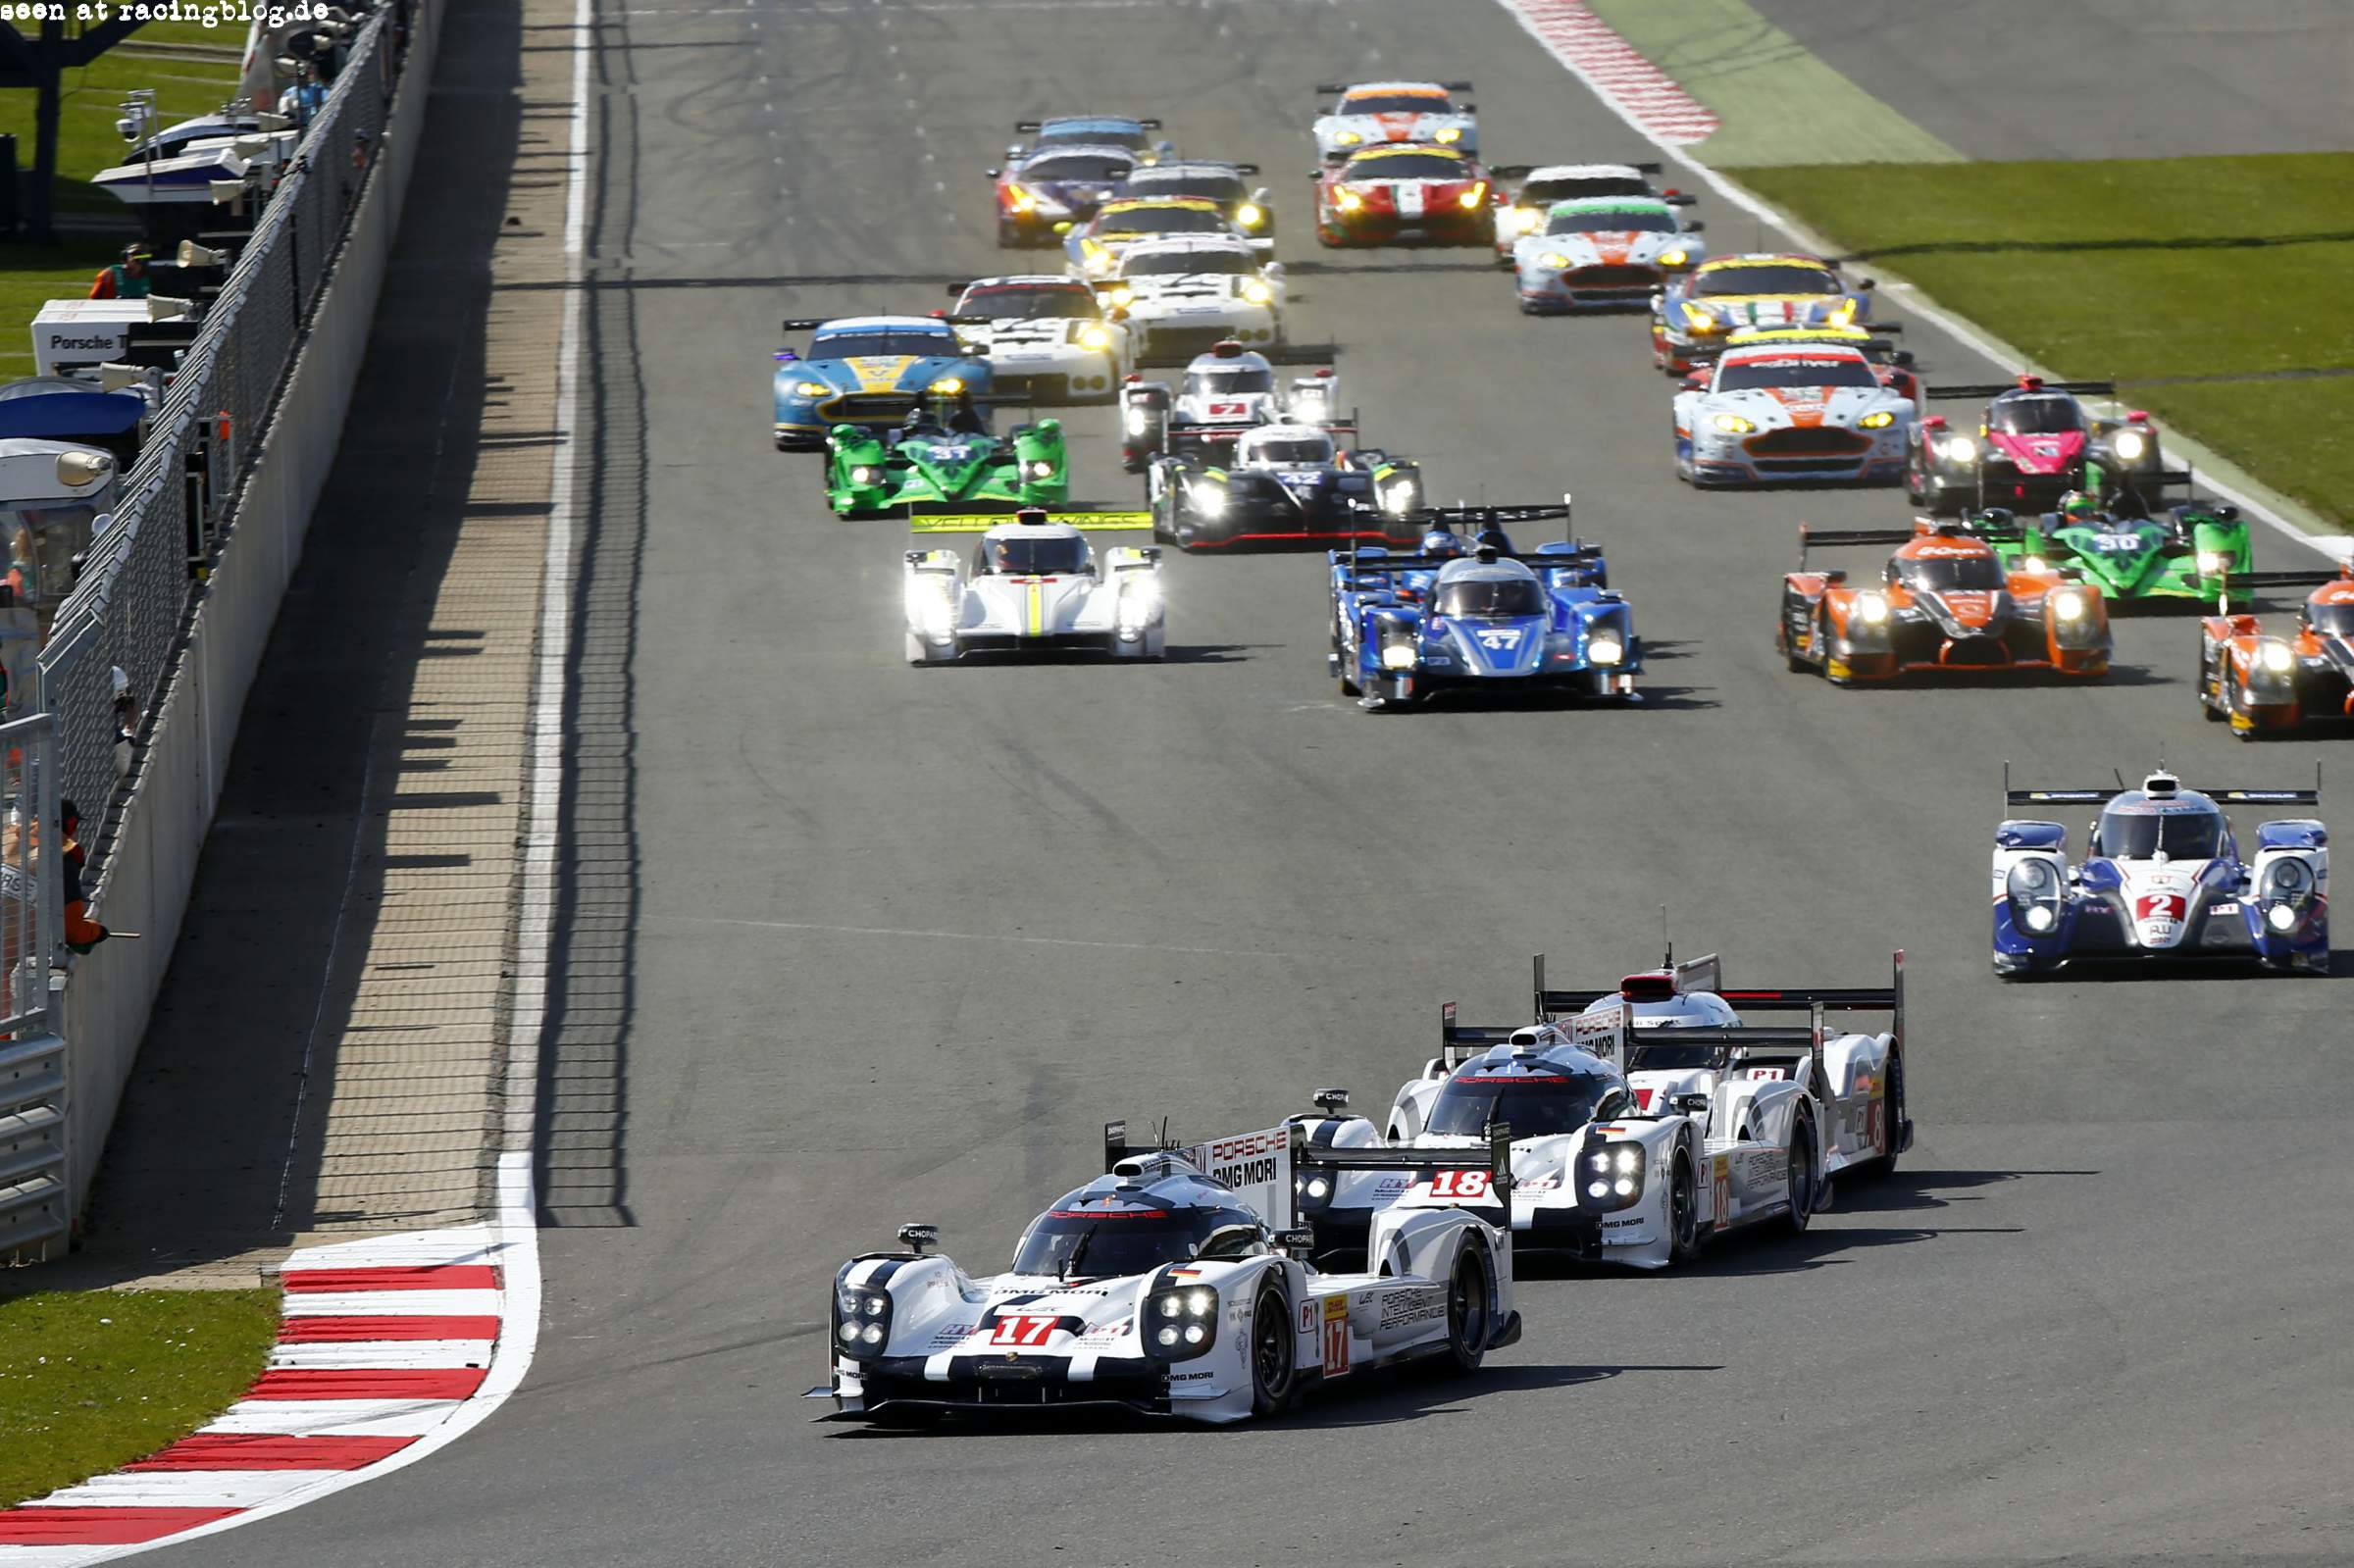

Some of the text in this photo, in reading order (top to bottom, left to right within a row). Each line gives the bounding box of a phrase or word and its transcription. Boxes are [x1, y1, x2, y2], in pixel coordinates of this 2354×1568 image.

[51, 335, 113, 349] Porsche
[1482, 635, 1520, 649] 47
[2149, 894, 2173, 916] 2
[1753, 1070, 1779, 1081] P1
[1873, 1104, 1883, 1148] 8
[1213, 1131, 1287, 1163] PORSCHE
[1244, 1157, 1277, 1187] MORI
[1432, 1171, 1487, 1195] 18
[1621, 1217, 1645, 1227] MORI
[1302, 1305, 1313, 1328] P1
[993, 1317, 1055, 1343] 17
[1325, 1321, 1346, 1370] 17
[1189, 1371, 1214, 1381] MORI
